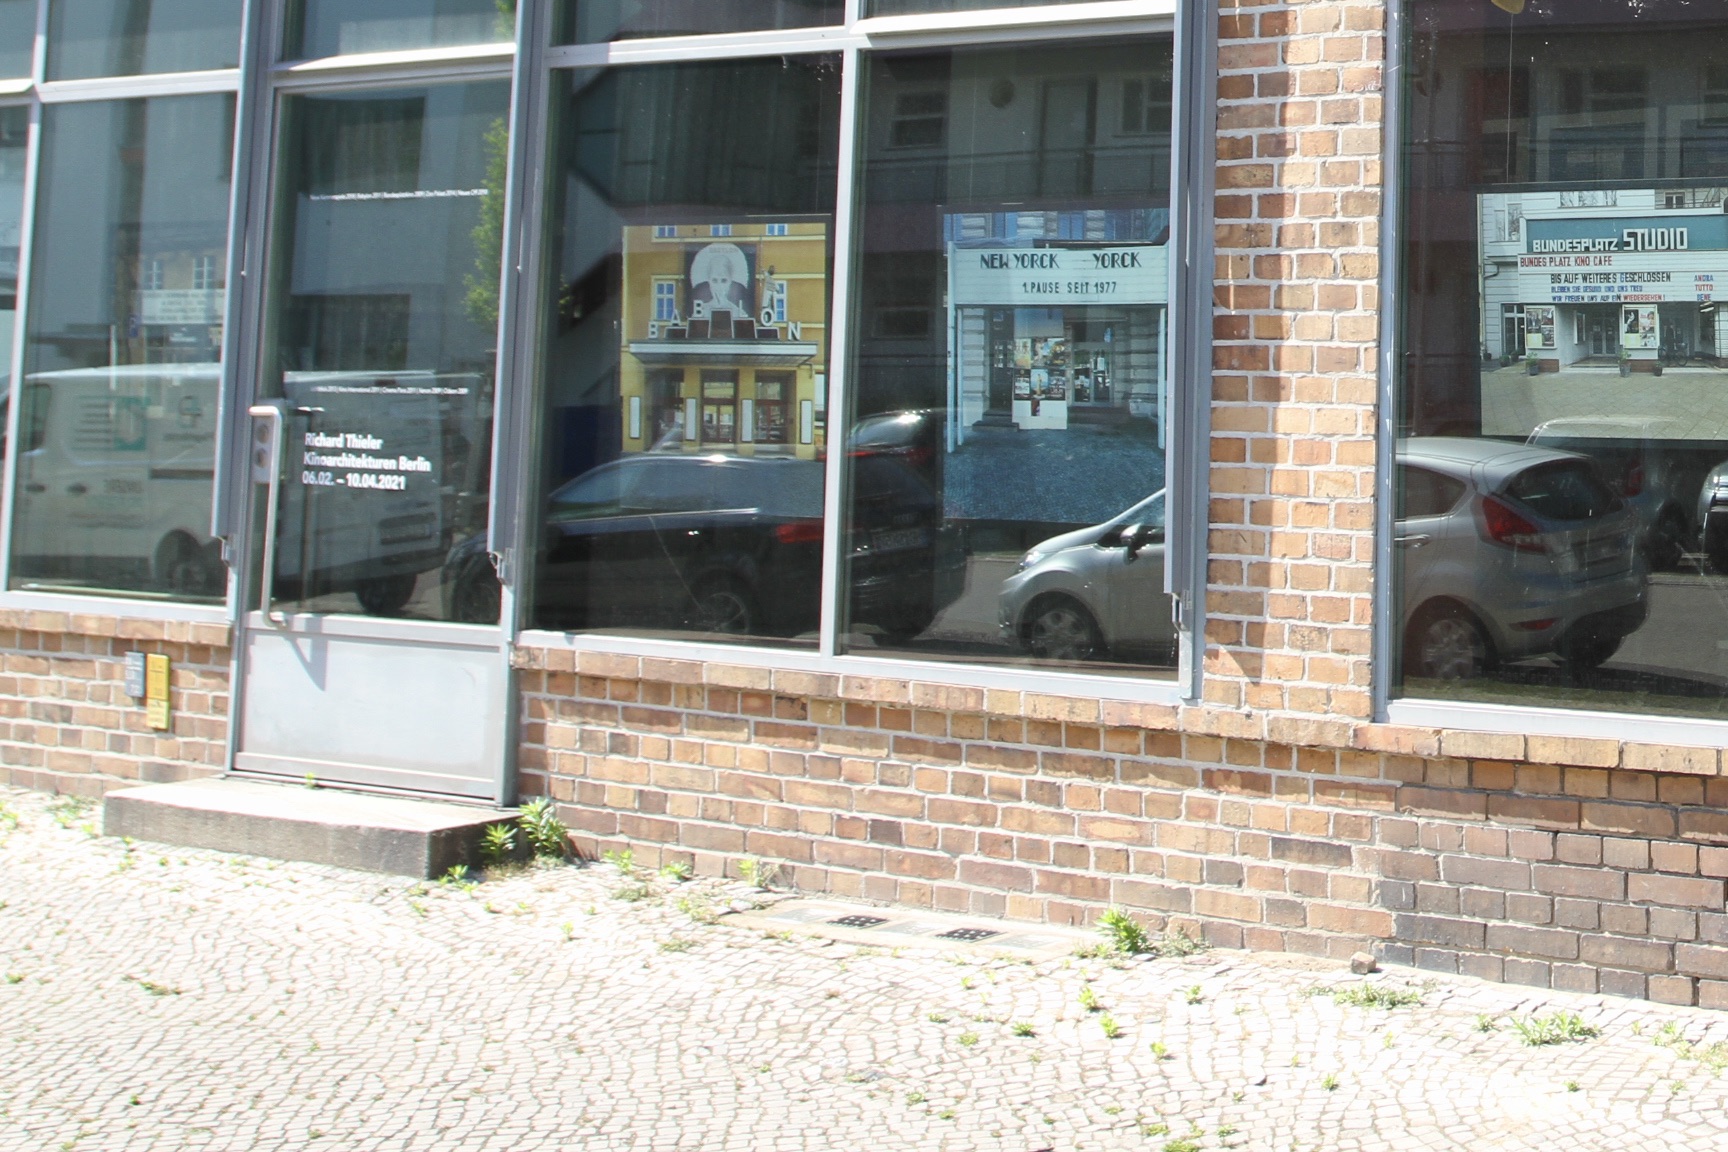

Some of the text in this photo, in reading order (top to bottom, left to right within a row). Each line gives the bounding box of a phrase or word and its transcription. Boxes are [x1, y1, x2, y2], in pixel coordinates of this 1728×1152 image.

[1532, 227, 1688, 253] BUNDESPLATZ STUDIO
[980, 253, 1060, 269] NEW YORCK
[1092, 252, 1142, 269] YORCK
[1520, 255, 1612, 267] BUNDES PLATZ KINO CAFE
[1550, 272, 1671, 284] BIS AUF WEITERES GESCHLOSSEN
[1067, 281, 1090, 294] SEIT
[1094, 281, 1117, 294] 1977
[305, 432, 384, 450] Richard Thieler
[303, 451, 432, 472] Kinoarchitekturen Berlin
[346, 472, 406, 491] 10.04.2021
